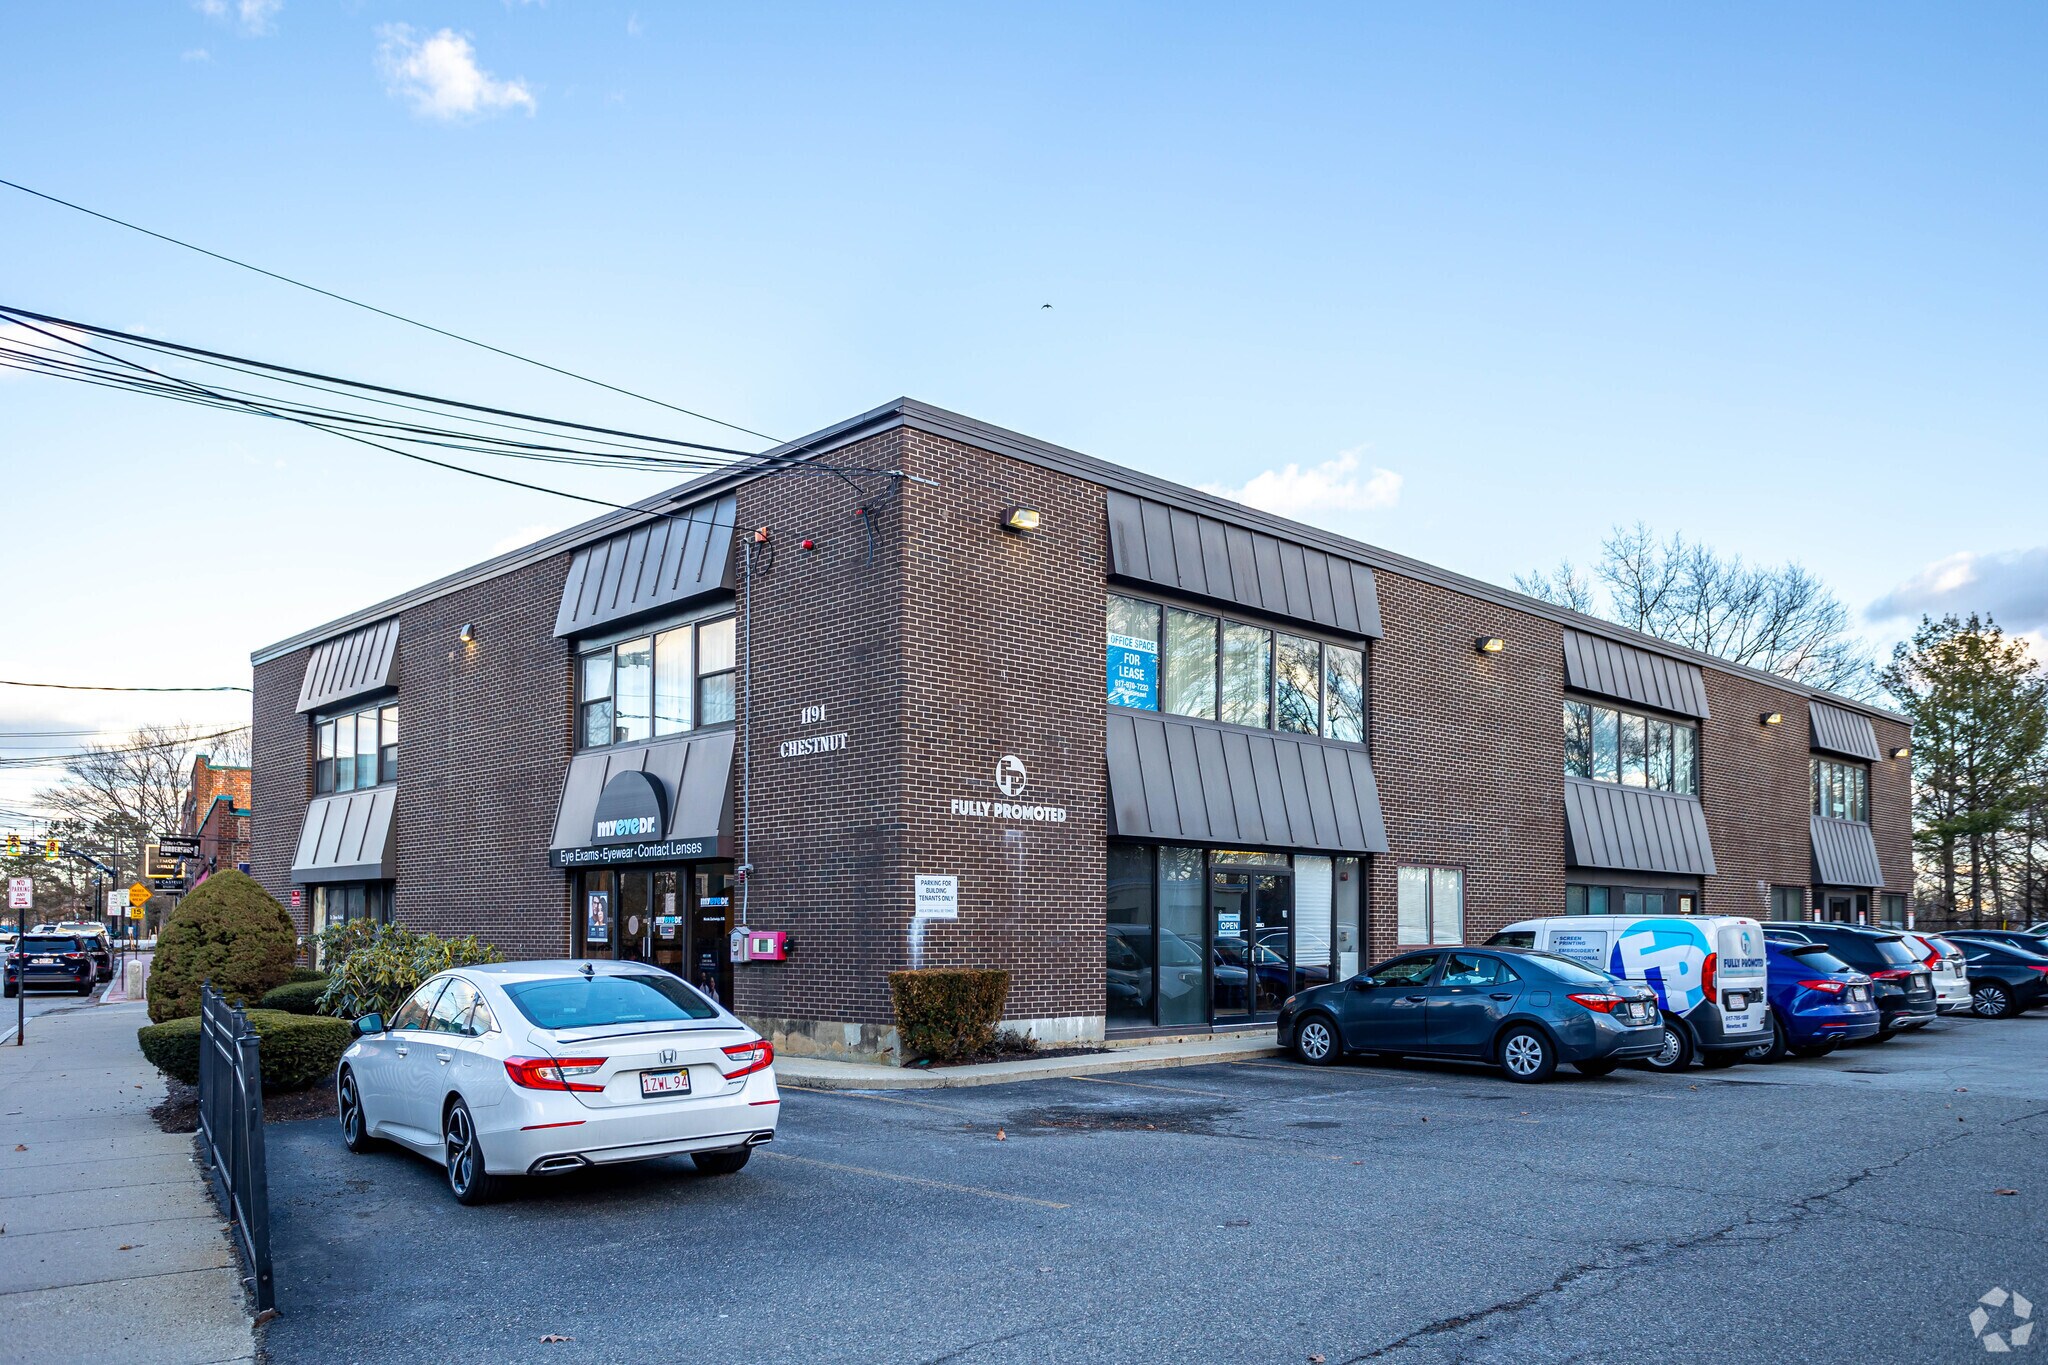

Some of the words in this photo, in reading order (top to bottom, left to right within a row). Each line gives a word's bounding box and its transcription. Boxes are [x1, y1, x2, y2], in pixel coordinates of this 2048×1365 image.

[1110, 634, 1133, 648] OFFICE
[1134, 639, 1155, 652] SPACE
[1123, 652, 1141, 666] FOR
[1119, 665, 1145, 681] LEASE
[801, 704, 826, 725] 1191
[780, 732, 848, 758] CHESTNUT
[951, 799, 992, 817] FULLY
[993, 802, 1067, 823] PROMOTED
[560, 849, 574, 865] Eye
[575, 848, 600, 862] Exams
[602, 846, 634, 863] Eyewear
[637, 842, 670, 858] Contact
[671, 841, 703, 855] Lenses
[920, 879, 941, 887] PARKING
[919, 894, 941, 902] TENANTS
[1220, 921, 1239, 930] OPEN
[1723, 958, 1740, 968] FULLY
[643, 1076, 672, 1092] 1ZWL
[673, 1074, 688, 1089] 94
